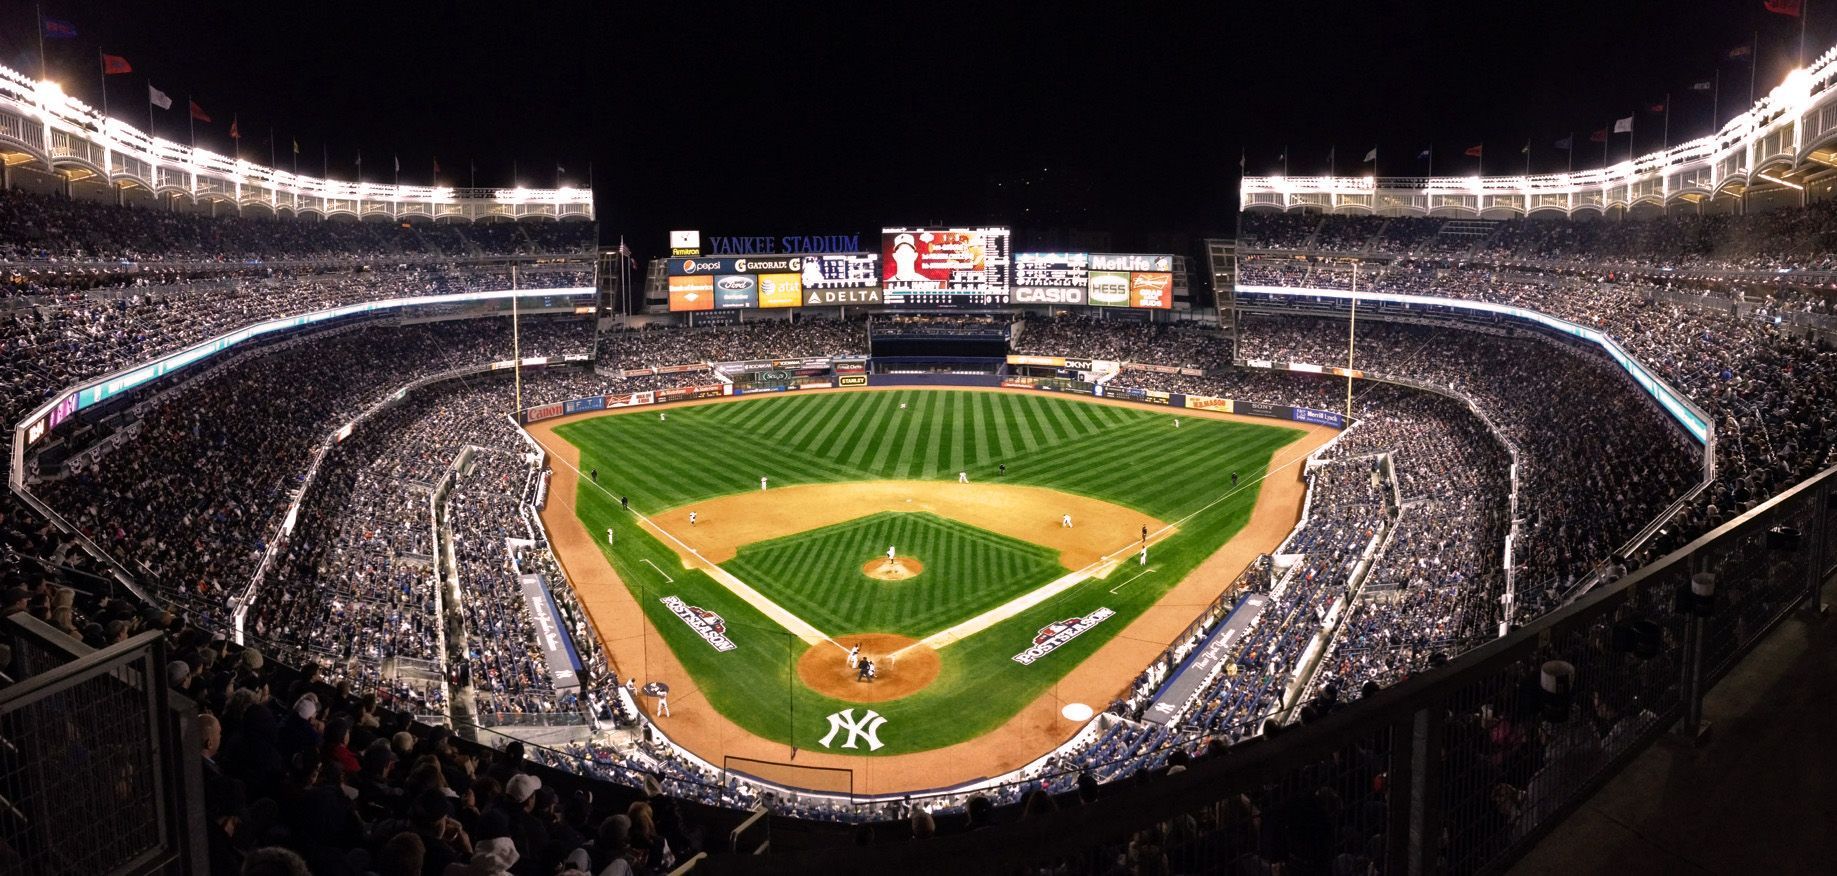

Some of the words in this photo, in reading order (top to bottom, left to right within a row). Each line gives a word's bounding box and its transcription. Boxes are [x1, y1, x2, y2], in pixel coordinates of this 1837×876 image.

[709, 236, 775, 254] YANKEE
[782, 235, 859, 254] STADIUM
[697, 261, 720, 271] pepsi
[1093, 255, 1150, 271] MetLife
[724, 280, 746, 289] Ford
[1092, 284, 1126, 295] HESS
[826, 290, 879, 302] DELTA
[1016, 287, 1082, 303] CASIO
[1065, 361, 1093, 369] DKNY
[528, 405, 563, 420] Canon
[1251, 403, 1273, 411] SONY
[1307, 411, 1324, 419] Merrill
[1324, 413, 1338, 422] Lynch
[660, 595, 737, 652] POSTSEASON
[1012, 608, 1115, 665] POSTSEASON
[818, 708, 888, 751] NY
